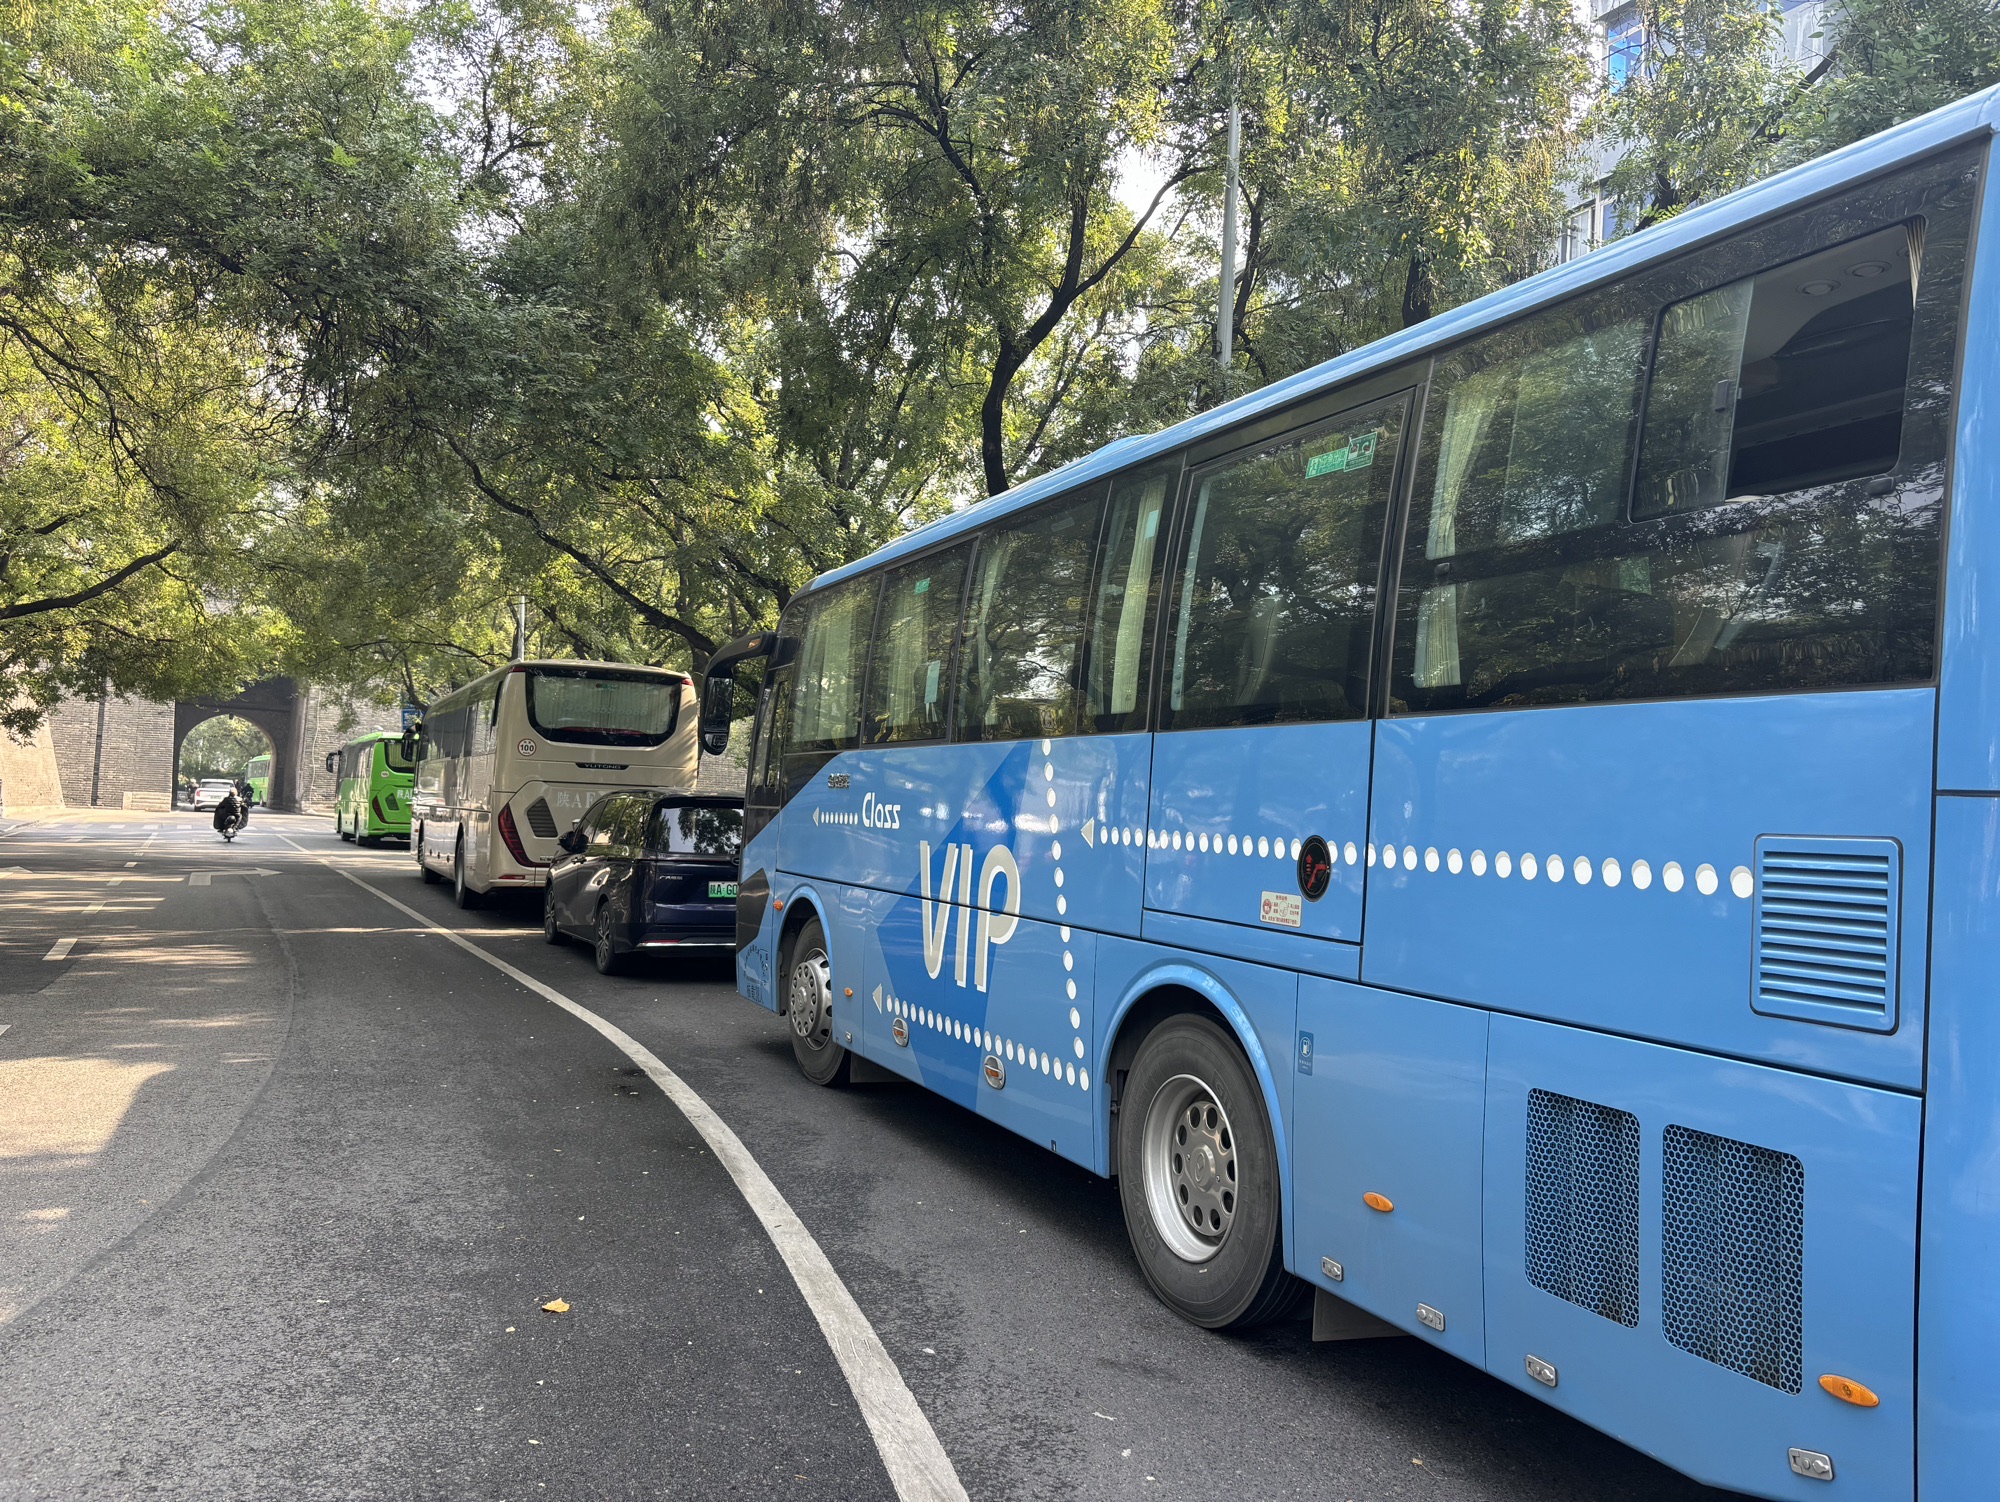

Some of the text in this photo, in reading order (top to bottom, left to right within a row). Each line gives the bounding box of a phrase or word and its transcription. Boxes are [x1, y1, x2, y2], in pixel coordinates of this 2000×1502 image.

[520, 744, 534, 752] 100
[862, 792, 901, 829] Class
[920, 840, 1021, 993] VIP
